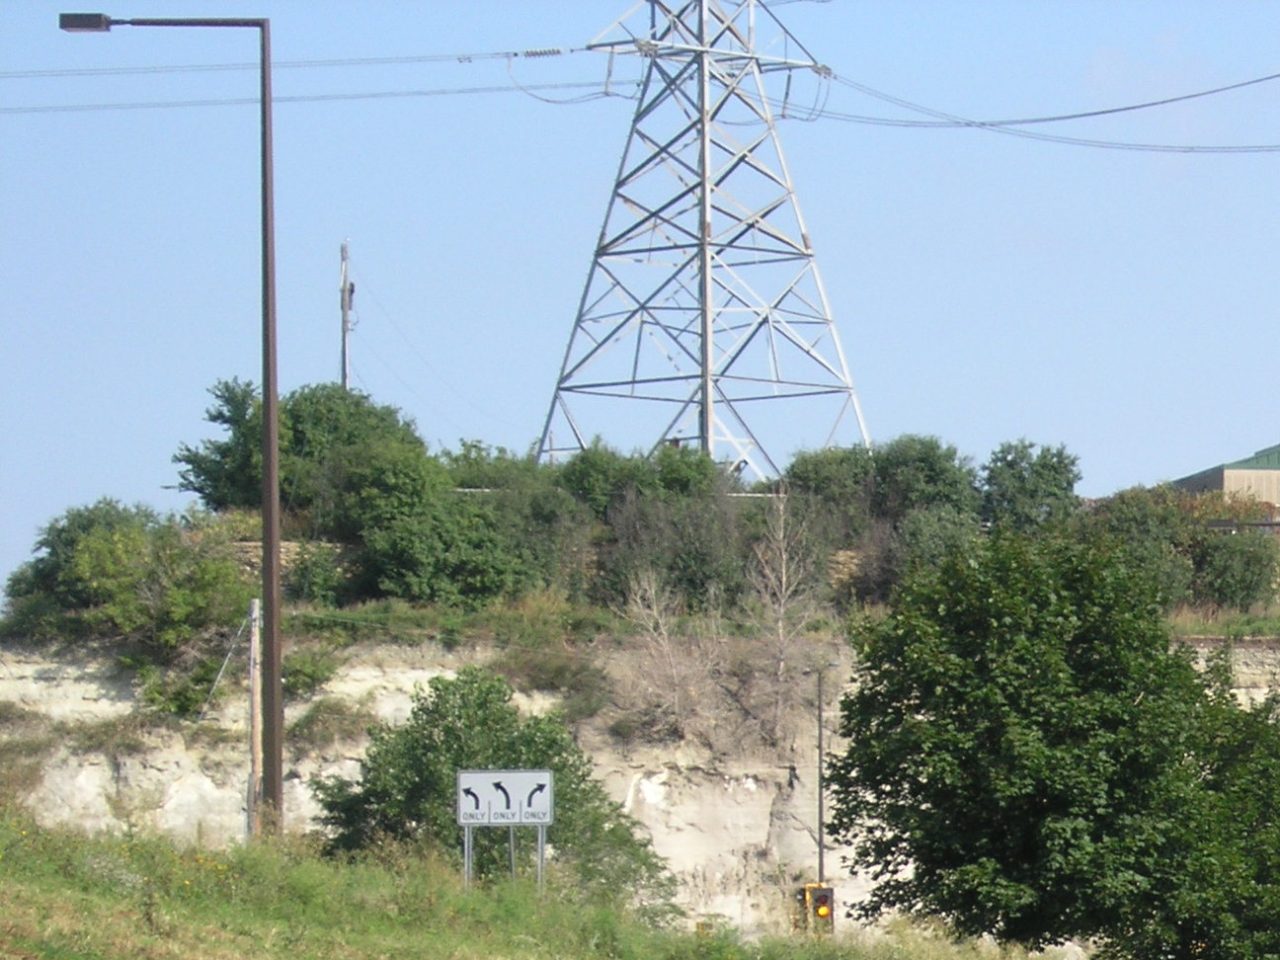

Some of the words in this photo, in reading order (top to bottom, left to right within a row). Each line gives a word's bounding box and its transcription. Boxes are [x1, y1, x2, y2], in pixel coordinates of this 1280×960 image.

[462, 811, 486, 820] ONLY
[493, 811, 517, 820] ONLY
[524, 811, 547, 820] ONLY
